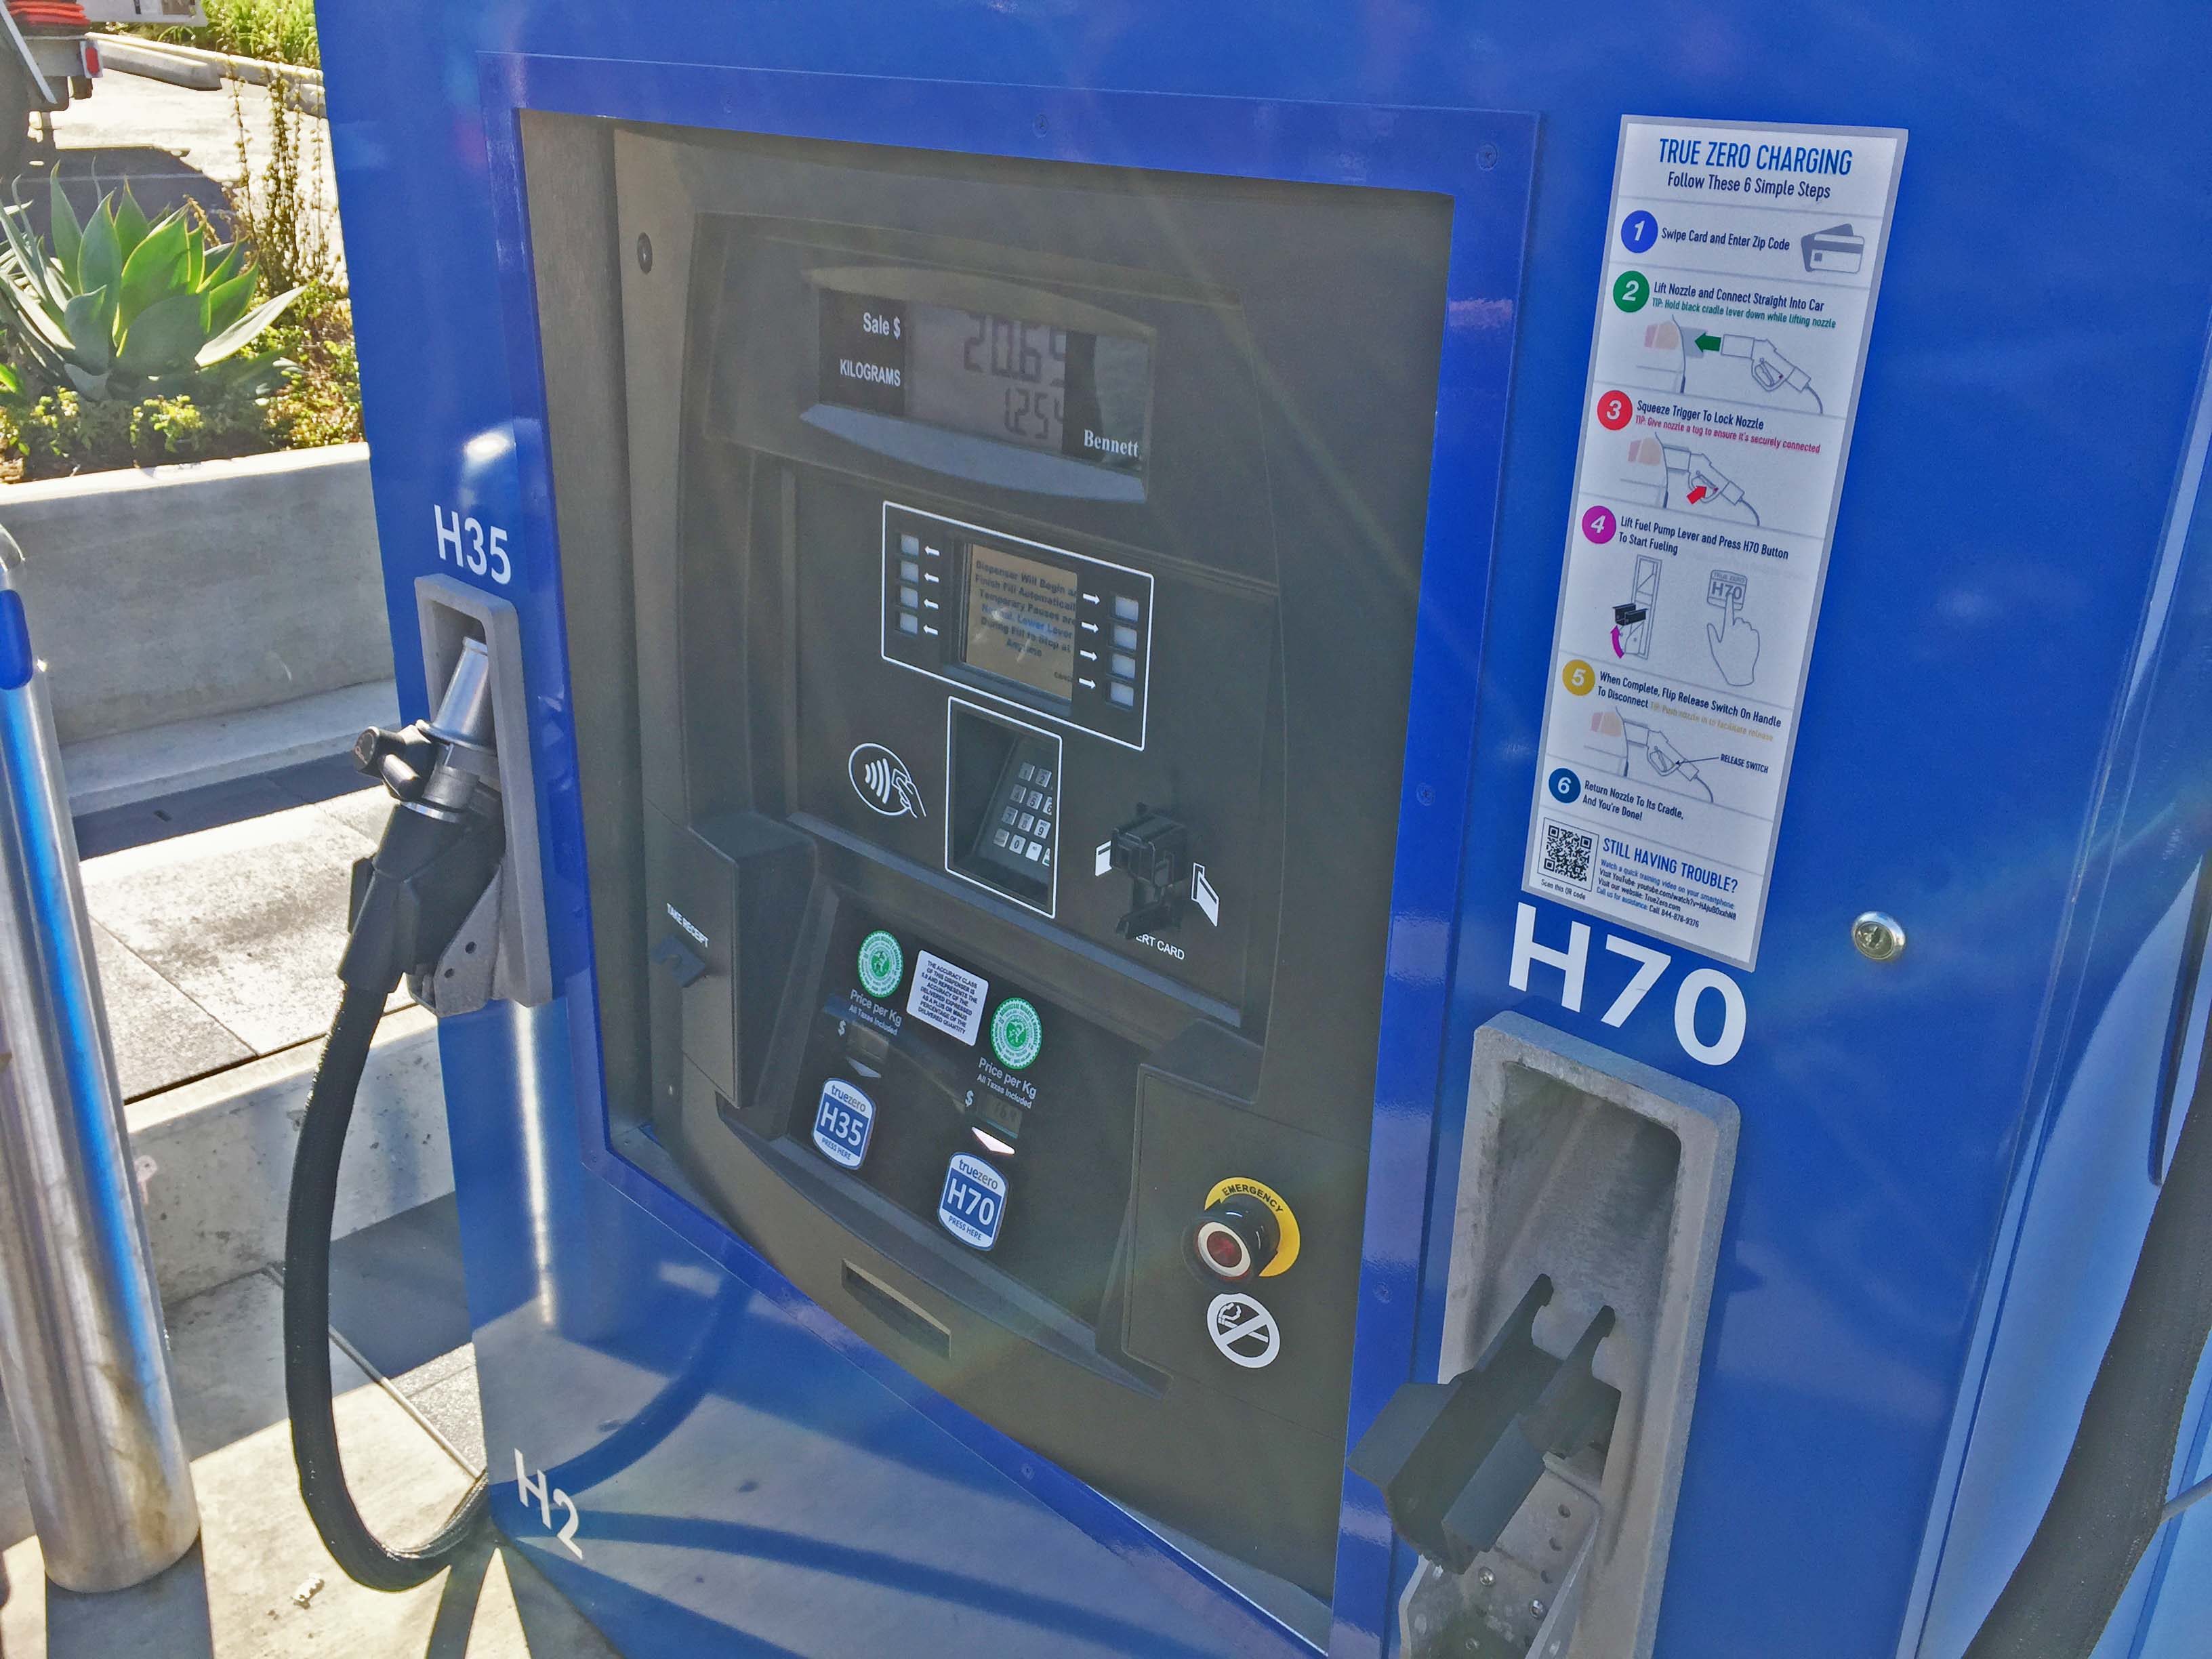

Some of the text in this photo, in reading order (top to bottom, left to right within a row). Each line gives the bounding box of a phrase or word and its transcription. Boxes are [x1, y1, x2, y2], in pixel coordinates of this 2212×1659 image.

[1659, 138, 1853, 176] TRUE ZERO CHARGING
[1667, 171, 1830, 201] Follow These 6 Simple Steps
[1634, 220, 1645, 241] 1
[1662, 227, 1790, 251] Swipe Card and Enter Zip Code
[1622, 280, 1639, 302] 2
[1654, 282, 1824, 312] Lift Nozzle and Connect Straight Into Car
[863, 312, 901, 340] Sale $
[1665, 299, 1679, 309] Hold
[1681, 301, 1700, 312] black
[1702, 304, 1724, 315] cradle
[1726, 307, 1744, 317] lever
[1746, 308, 1765, 320] down
[1767, 311, 1787, 323] while
[1789, 314, 1809, 328] lifting
[1812, 318, 1836, 329] nozzle
[840, 359, 901, 387] KILOGRAMS
[1606, 400, 1622, 421] 3
[1637, 400, 1764, 430] Squeeze Trigger To Lock Nozzle
[1084, 428, 1140, 457] Bennett
[1647, 417, 1662, 428] Give
[1663, 419, 1685, 432] nozzle
[1686, 424, 1691, 433] a
[1692, 424, 1703, 436] tug
[1704, 427, 1712, 436] to
[1713, 428, 1737, 441] ensure
[1739, 432, 1748, 442] it's
[1750, 434, 1780, 449] securely
[1782, 438, 1820, 454] connected
[1591, 514, 1605, 533] 4
[434, 504, 512, 585] H35
[1618, 532, 1679, 556] To Start Fueling
[1621, 516, 1789, 560] Lift Fuel Pump Lever and Press H70 Button
[1021, 572, 1038, 586] Will
[1712, 581, 1742, 600] H70
[1571, 668, 1586, 687] 5
[1597, 686, 1648, 709] To Disconnect
[1600, 670, 1782, 728] When Complete, Flip Release Switch On Handle
[1721, 753, 1769, 774] RELEASE SWITCH
[1558, 777, 1572, 794] 6
[1582, 794, 1643, 821] And You're Done!
[1584, 780, 1684, 820] Return Nozzle To Its Cradle.
[1603, 838, 1738, 893] STILL HAVING TROUBLE?
[1157, 940, 1185, 960] CARD
[1508, 902, 1746, 1065] H70
[850, 989, 902, 1027] Price per Kg
[838, 1020, 846, 1036] $
[977, 1073, 986, 1084] All
[1005, 1088, 1032, 1109] Included
[979, 1057, 1037, 1099] Price per Kg
[832, 1084, 866, 1112] truezero
[965, 1090, 974, 1107] $
[821, 1101, 863, 1146] H35
[821, 1137, 852, 1160] PRESS HERE
[959, 1159, 998, 1189] truezero
[947, 1178, 995, 1226] H70
[1222, 1184, 1283, 1212] EMERGENCY
[949, 1215, 982, 1241] PRESS HERE
